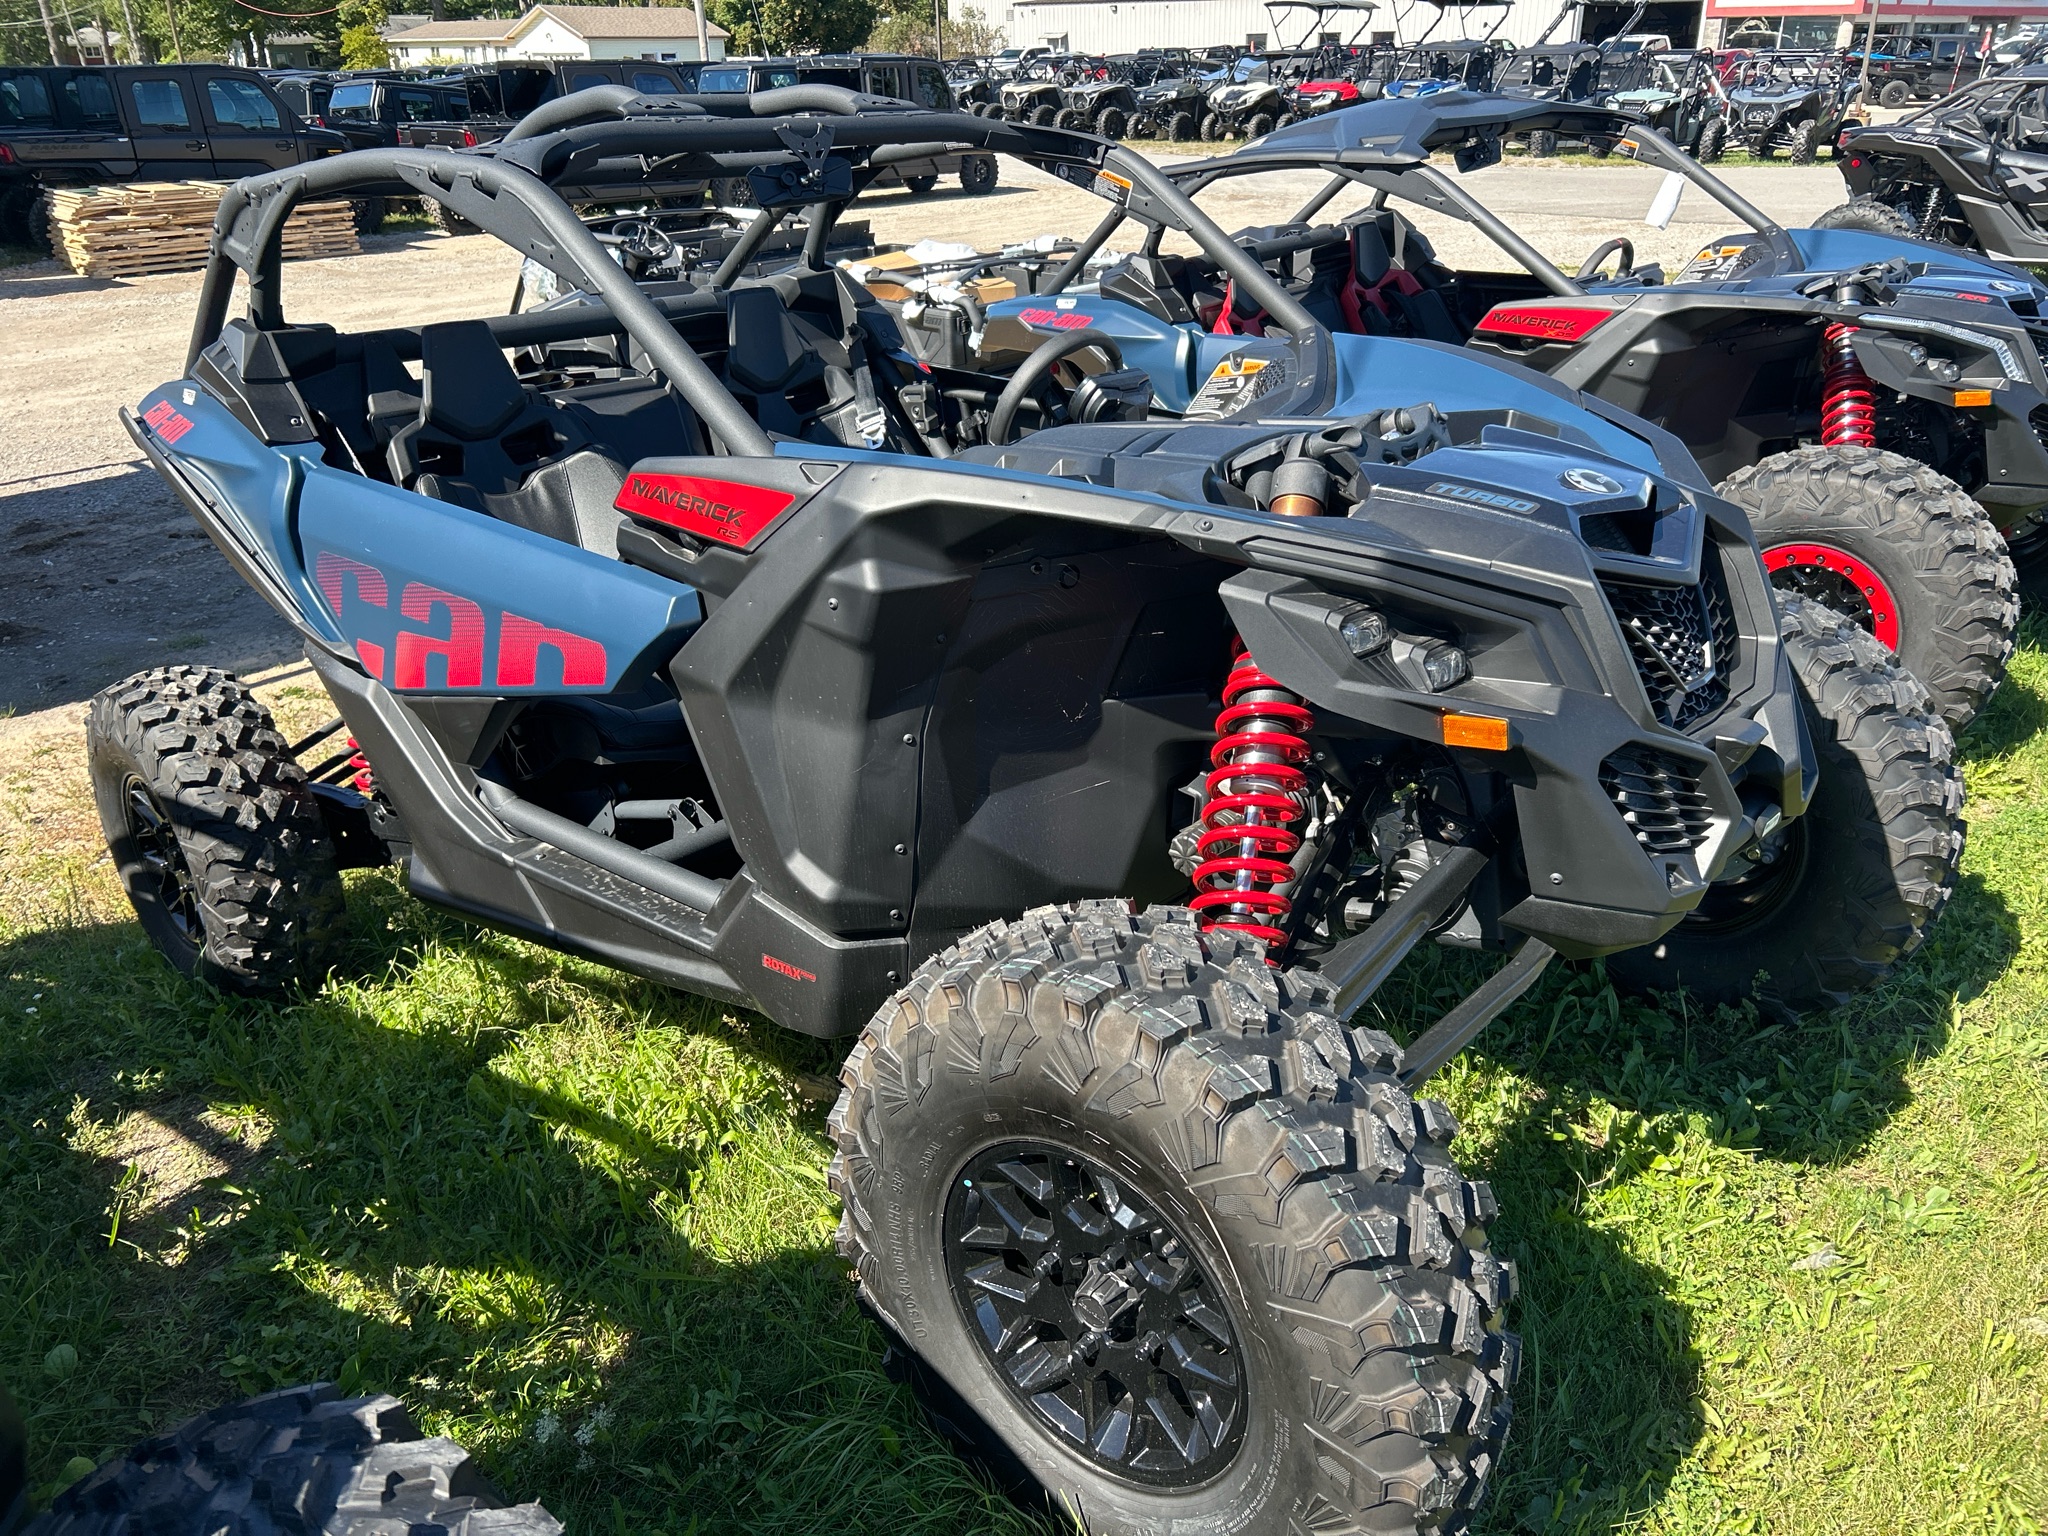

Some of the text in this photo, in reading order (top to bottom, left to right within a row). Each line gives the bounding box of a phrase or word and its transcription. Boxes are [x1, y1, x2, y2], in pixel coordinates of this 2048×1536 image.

[1889, 131, 1941, 145] an-am
[1492, 312, 1578, 331] MAVERICK
[631, 477, 747, 528] MAVERICK
[1434, 482, 1535, 512] TURBO
[716, 526, 741, 540] RS
[762, 954, 802, 981] ROTAX
